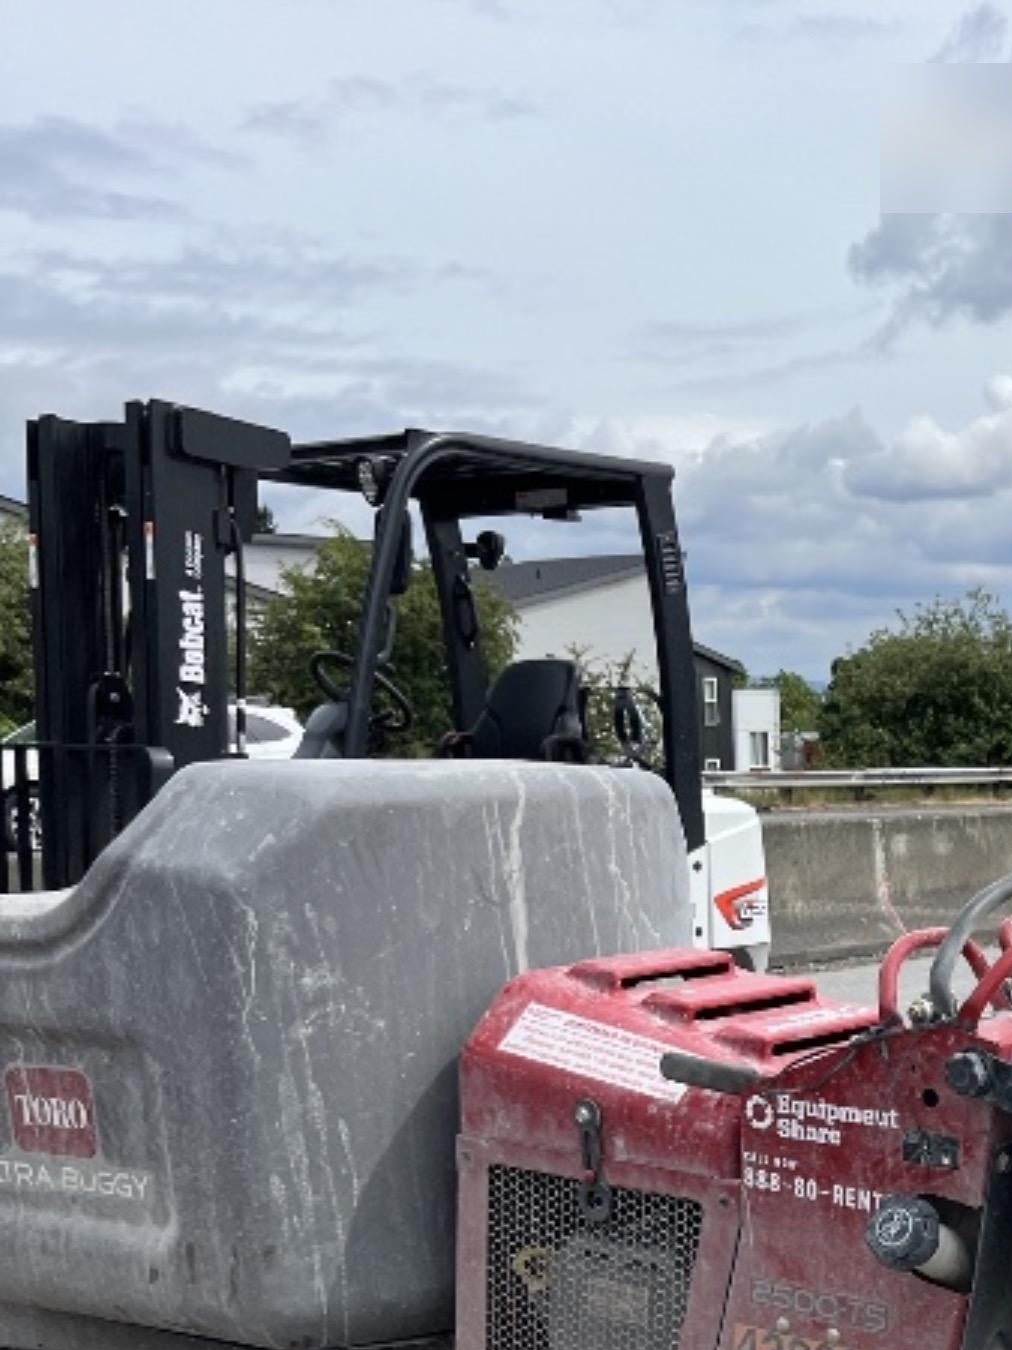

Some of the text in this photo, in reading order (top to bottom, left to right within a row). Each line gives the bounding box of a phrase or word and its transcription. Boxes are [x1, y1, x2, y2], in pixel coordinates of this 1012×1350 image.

[178, 589, 205, 684] Bobcat
[14, 1094, 88, 1129] TORO
[776, 1094, 900, 1129] Equipment
[776, 1118, 842, 1146] Share
[0, 1160, 148, 1199] TRA BUGGY
[743, 1167, 885, 1213] 888-80-RENT
